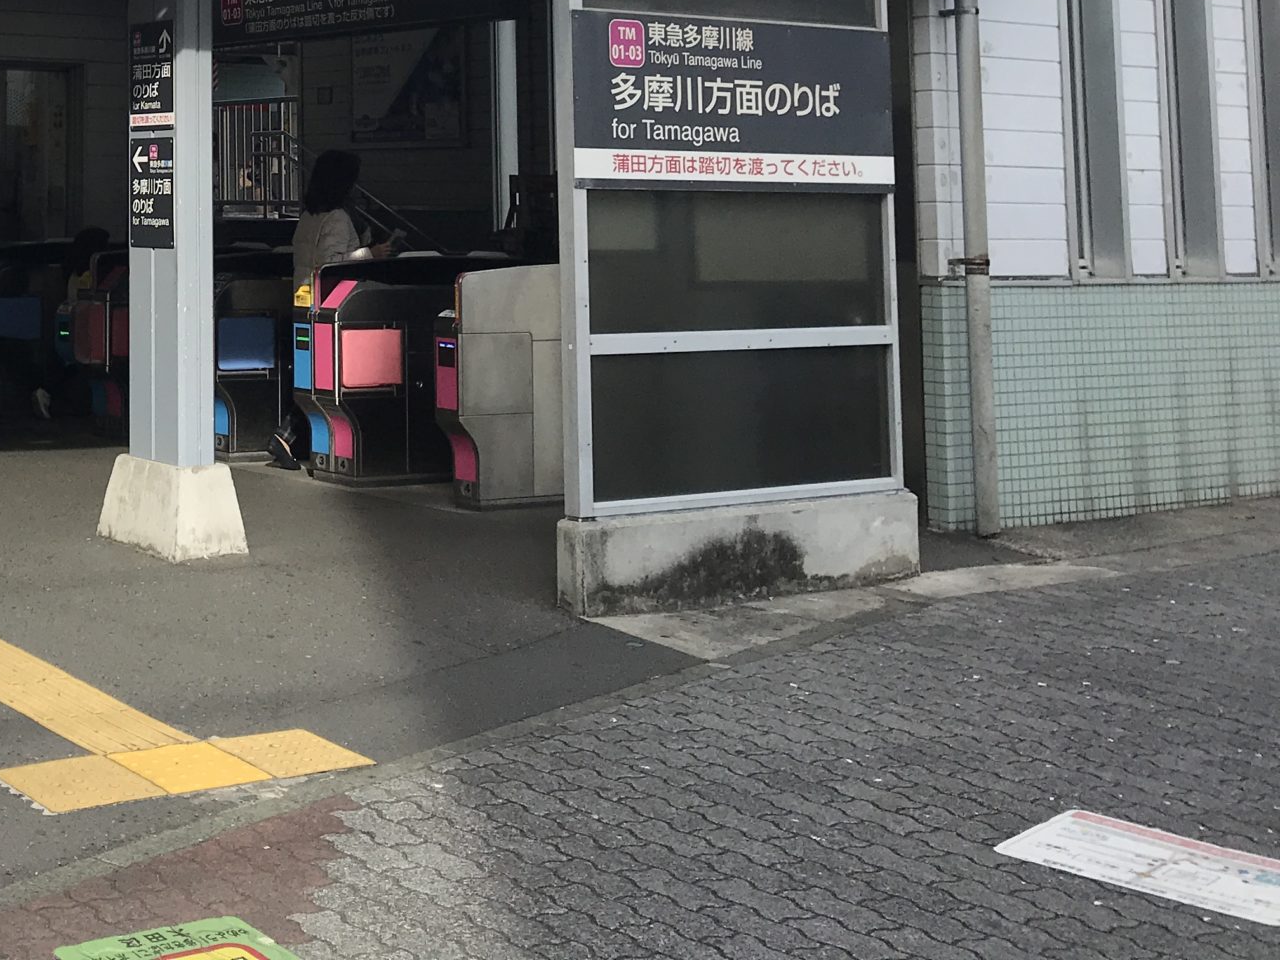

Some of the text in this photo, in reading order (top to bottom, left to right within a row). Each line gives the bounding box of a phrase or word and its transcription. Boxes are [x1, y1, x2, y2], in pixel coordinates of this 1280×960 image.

[222, 7, 241, 22] 01-03
[266, 3, 306, 18] Tamagawa
[306, 0, 323, 12] Line
[618, 26, 636, 41] TM
[648, 21, 754, 52] 東急多摩川線
[612, 44, 642, 61] 01-03
[683, 52, 739, 70] Tamagawa
[741, 55, 763, 70] Line
[132, 61, 172, 81] 蒲田方面
[132, 81, 160, 99] のりば
[610, 72, 841, 118] 多摩川方面のりば
[140, 100, 161, 110] Kamata
[611, 118, 740, 147] for Tamagawa
[612, 154, 864, 178] 蒲田方面は踏切を渡ってください。
[132, 178, 171, 195] 多摩川方面
[132, 197, 154, 214] のりば
[141, 216, 169, 228] Tamagawa
[117, 927, 192, 948] 大田区
